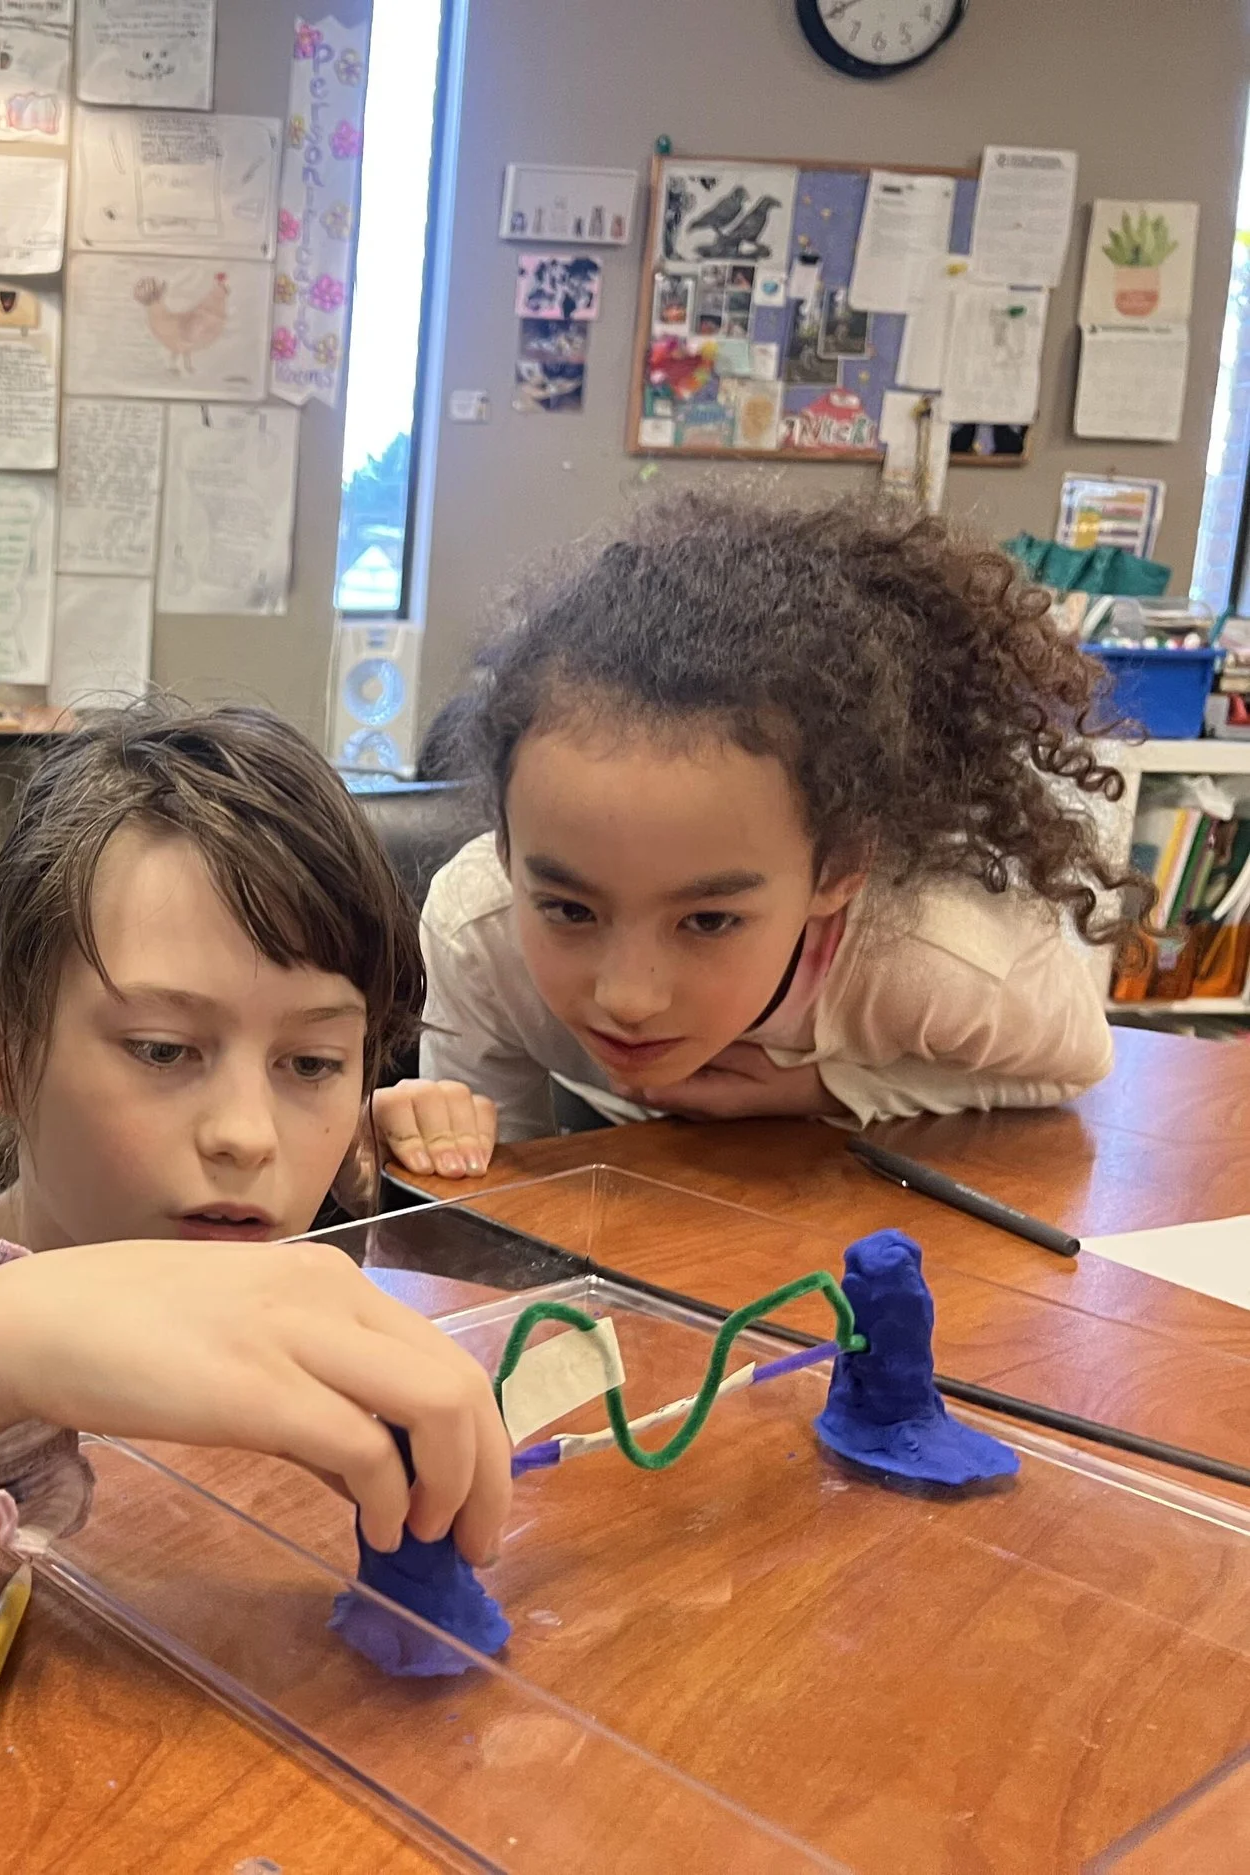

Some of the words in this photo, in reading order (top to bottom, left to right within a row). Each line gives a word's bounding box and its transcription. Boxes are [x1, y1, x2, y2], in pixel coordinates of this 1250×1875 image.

[850, 20, 862, 42] 7
[871, 31, 888, 52] 6
[899, 22, 912, 46] 5
